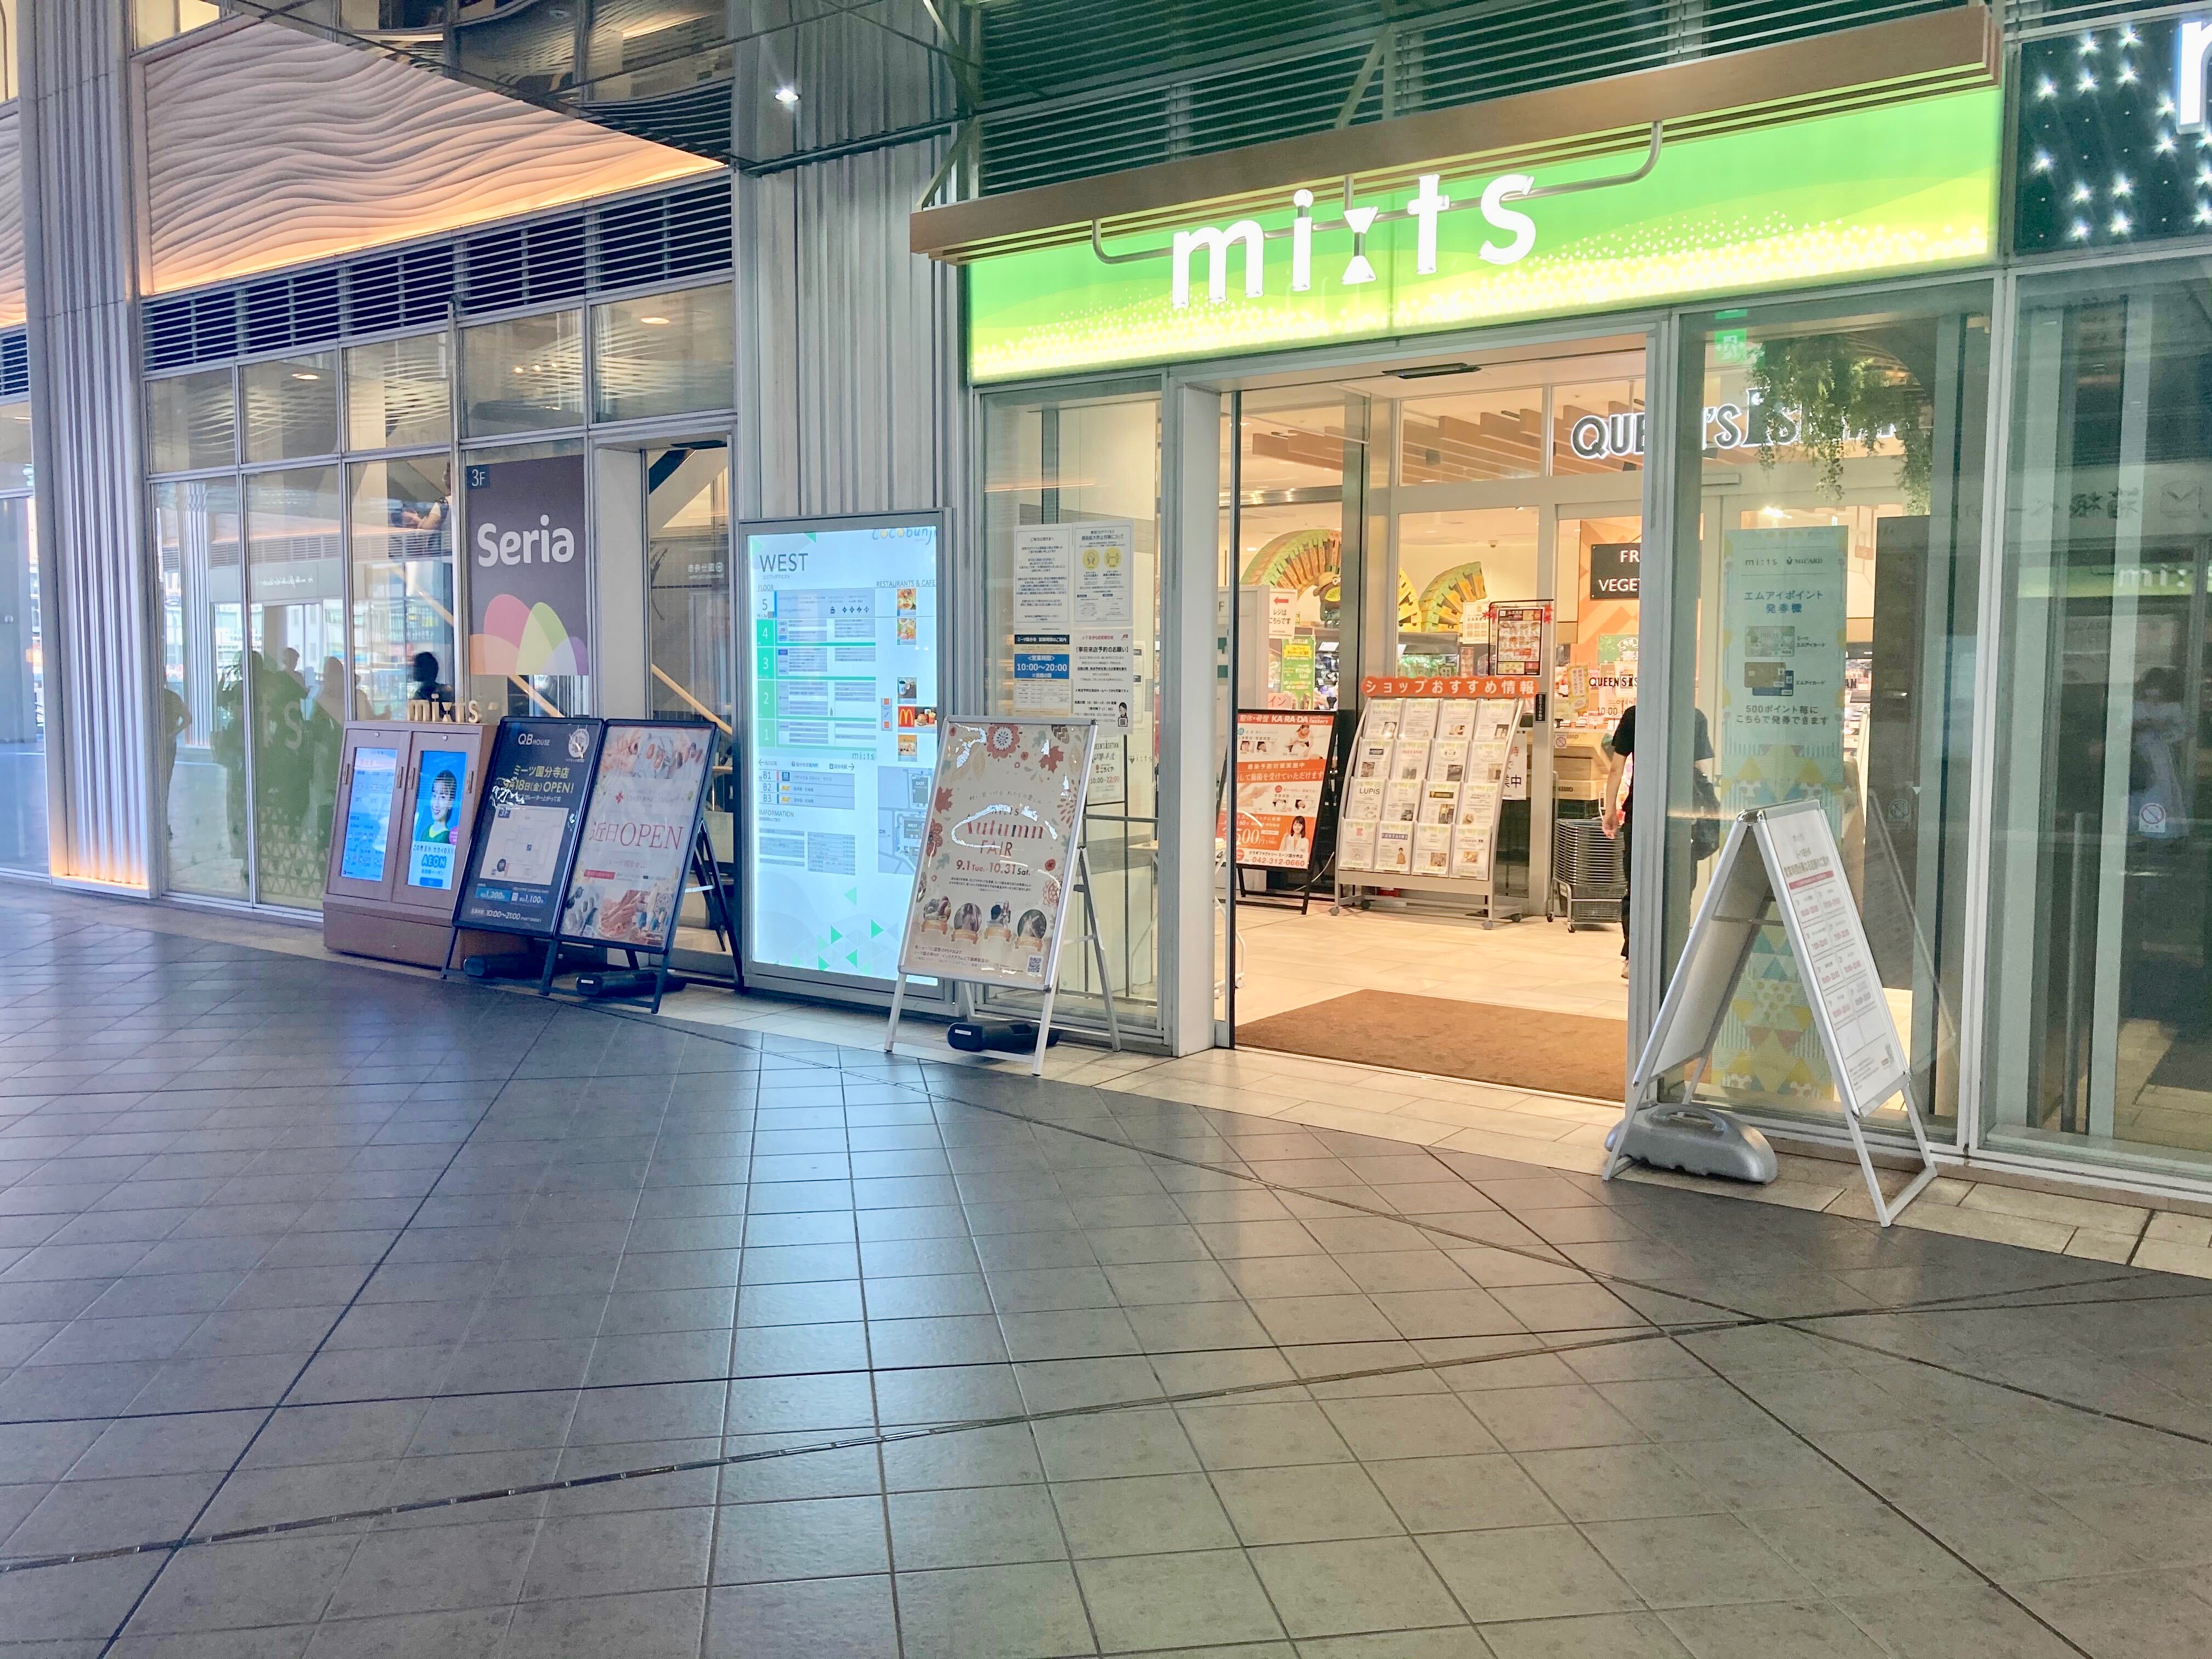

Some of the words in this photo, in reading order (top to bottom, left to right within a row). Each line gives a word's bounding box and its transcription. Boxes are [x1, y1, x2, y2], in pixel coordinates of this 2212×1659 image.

[471, 469, 486, 487] 3F
[477, 514, 574, 567] Seria
[759, 553, 808, 572] WEST
[1744, 590, 1824, 601] エムアイポイント
[762, 599, 768, 611] 5
[1765, 603, 1803, 614] 発券機
[762, 627, 768, 639] 4
[763, 657, 769, 670] 3
[1365, 679, 1535, 695] ショップおすすめ情報
[763, 692, 769, 704] 2
[1745, 705, 1818, 714] 500ポイント毎に
[1736, 715, 1829, 725] こちらで発券できます
[518, 733, 533, 746] QB
[764, 729, 769, 741] 1
[513, 765, 570, 779] ミーツ国分寺店
[763, 771, 771, 780] B1
[543, 781, 574, 794] OPEN!
[763, 783, 771, 791] B2
[763, 794, 772, 802] B3
[499, 807, 511, 817] 3F
[421, 854, 447, 868] AEON
[956, 860, 970, 871] 9.1
[1252, 856, 1305, 867] 042-312-0660
